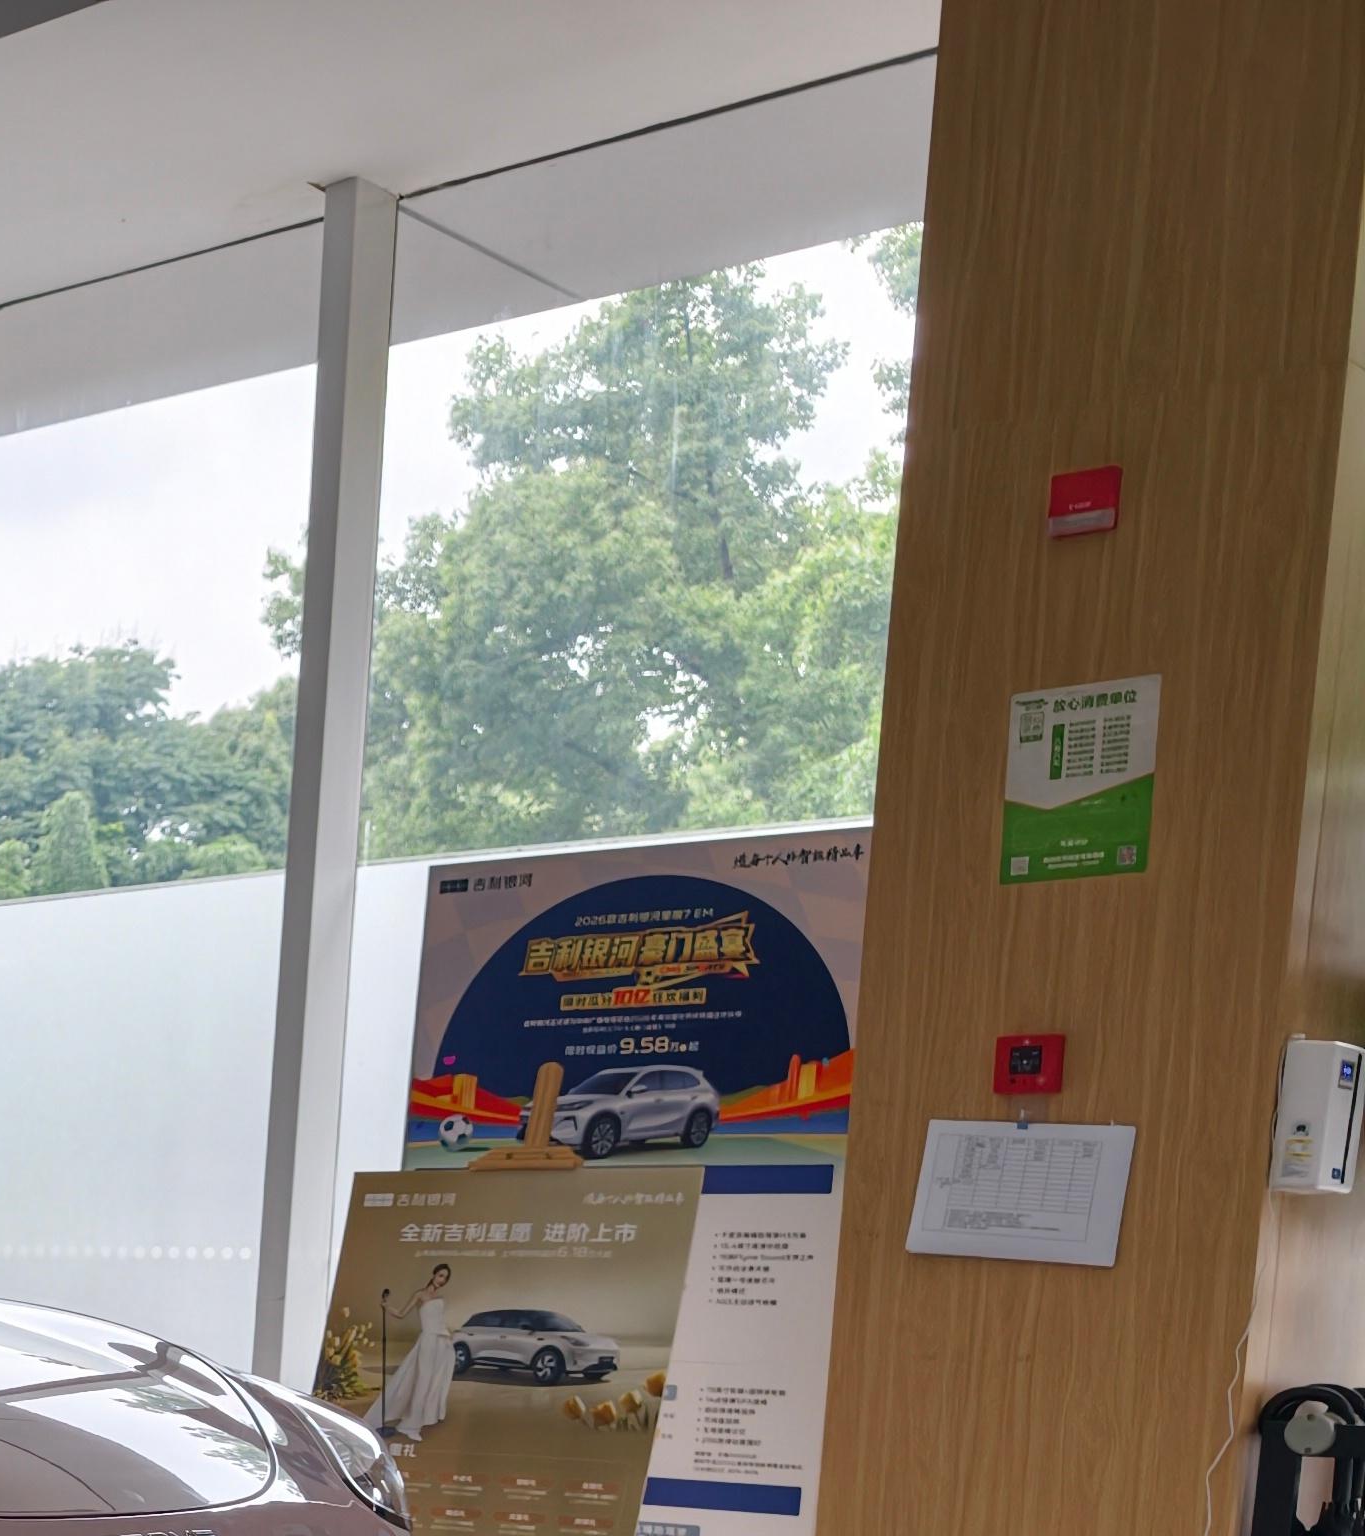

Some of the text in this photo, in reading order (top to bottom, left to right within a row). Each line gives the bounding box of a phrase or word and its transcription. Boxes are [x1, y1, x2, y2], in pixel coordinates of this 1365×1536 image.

[399, 1223, 638, 1243] 全新吉利星愿 进阶上市
